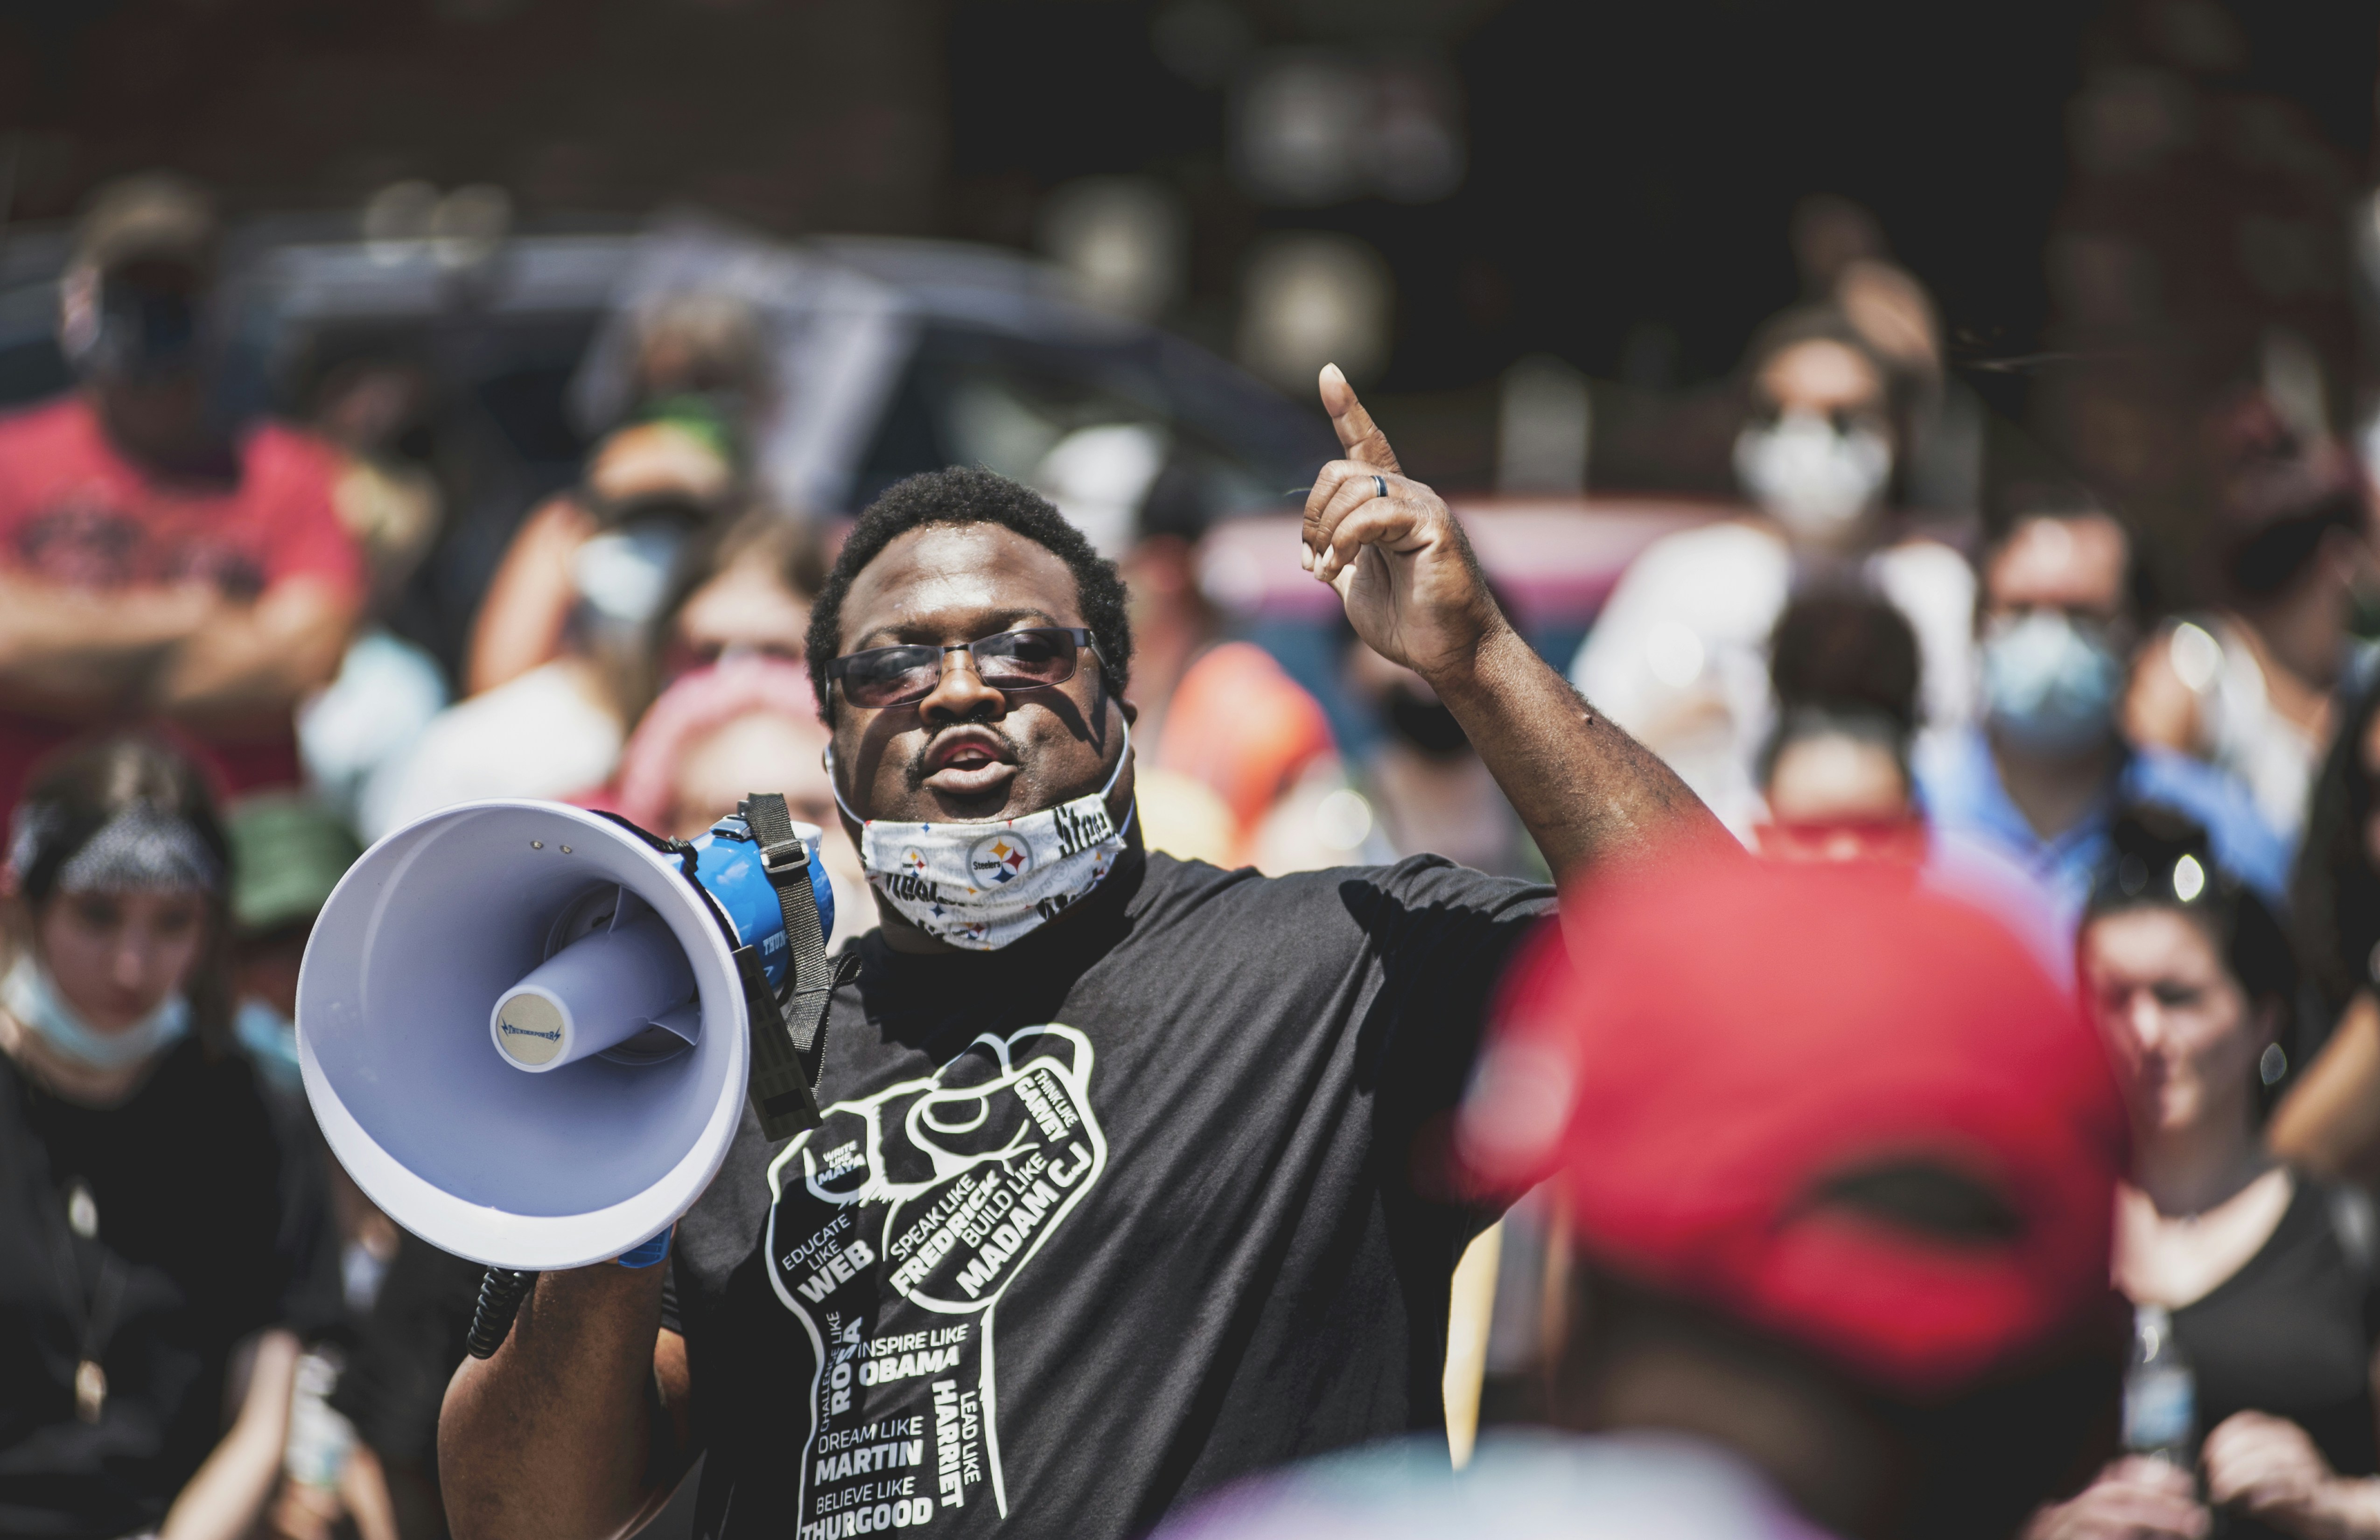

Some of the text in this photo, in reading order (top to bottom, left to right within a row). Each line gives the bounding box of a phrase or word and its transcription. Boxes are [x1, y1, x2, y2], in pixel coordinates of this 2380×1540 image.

[973, 860, 1001, 870] Steelers
[508, 1024, 554, 1041] THUNDERPOWER
[1014, 1076, 1069, 1142] GARVEY
[1035, 1069, 1079, 1128] THINK LIKE
[818, 1153, 867, 1186] MAYA
[823, 1140, 857, 1162] WRITE
[829, 1151, 852, 1168] LIKE
[890, 1173, 978, 1261] SPEAK LIKE
[961, 1152, 1049, 1248] BUILD LIKE
[782, 1213, 851, 1271] EDUCATE
[807, 1239, 841, 1271] LIKE
[889, 1169, 1002, 1297] FREDRICK
[956, 1179, 1060, 1299] MADAM
[797, 1239, 875, 1303] WEB
[831, 1316, 862, 1415] ROSA
[858, 1323, 969, 1358] INSPIRE LIKE
[858, 1345, 960, 1386] OBAMA
[820, 1311, 841, 1433] CHALLENGE LIKE
[818, 1415, 924, 1455] DREAM LIKE
[932, 1379, 965, 1508] HARRIET
[960, 1390, 982, 1485] LEAD LIKE
[814, 1439, 924, 1487] MARTIN
[801, 1497, 933, 1540] THURGOOD
[816, 1476, 917, 1515] BELIEVE LIKE
